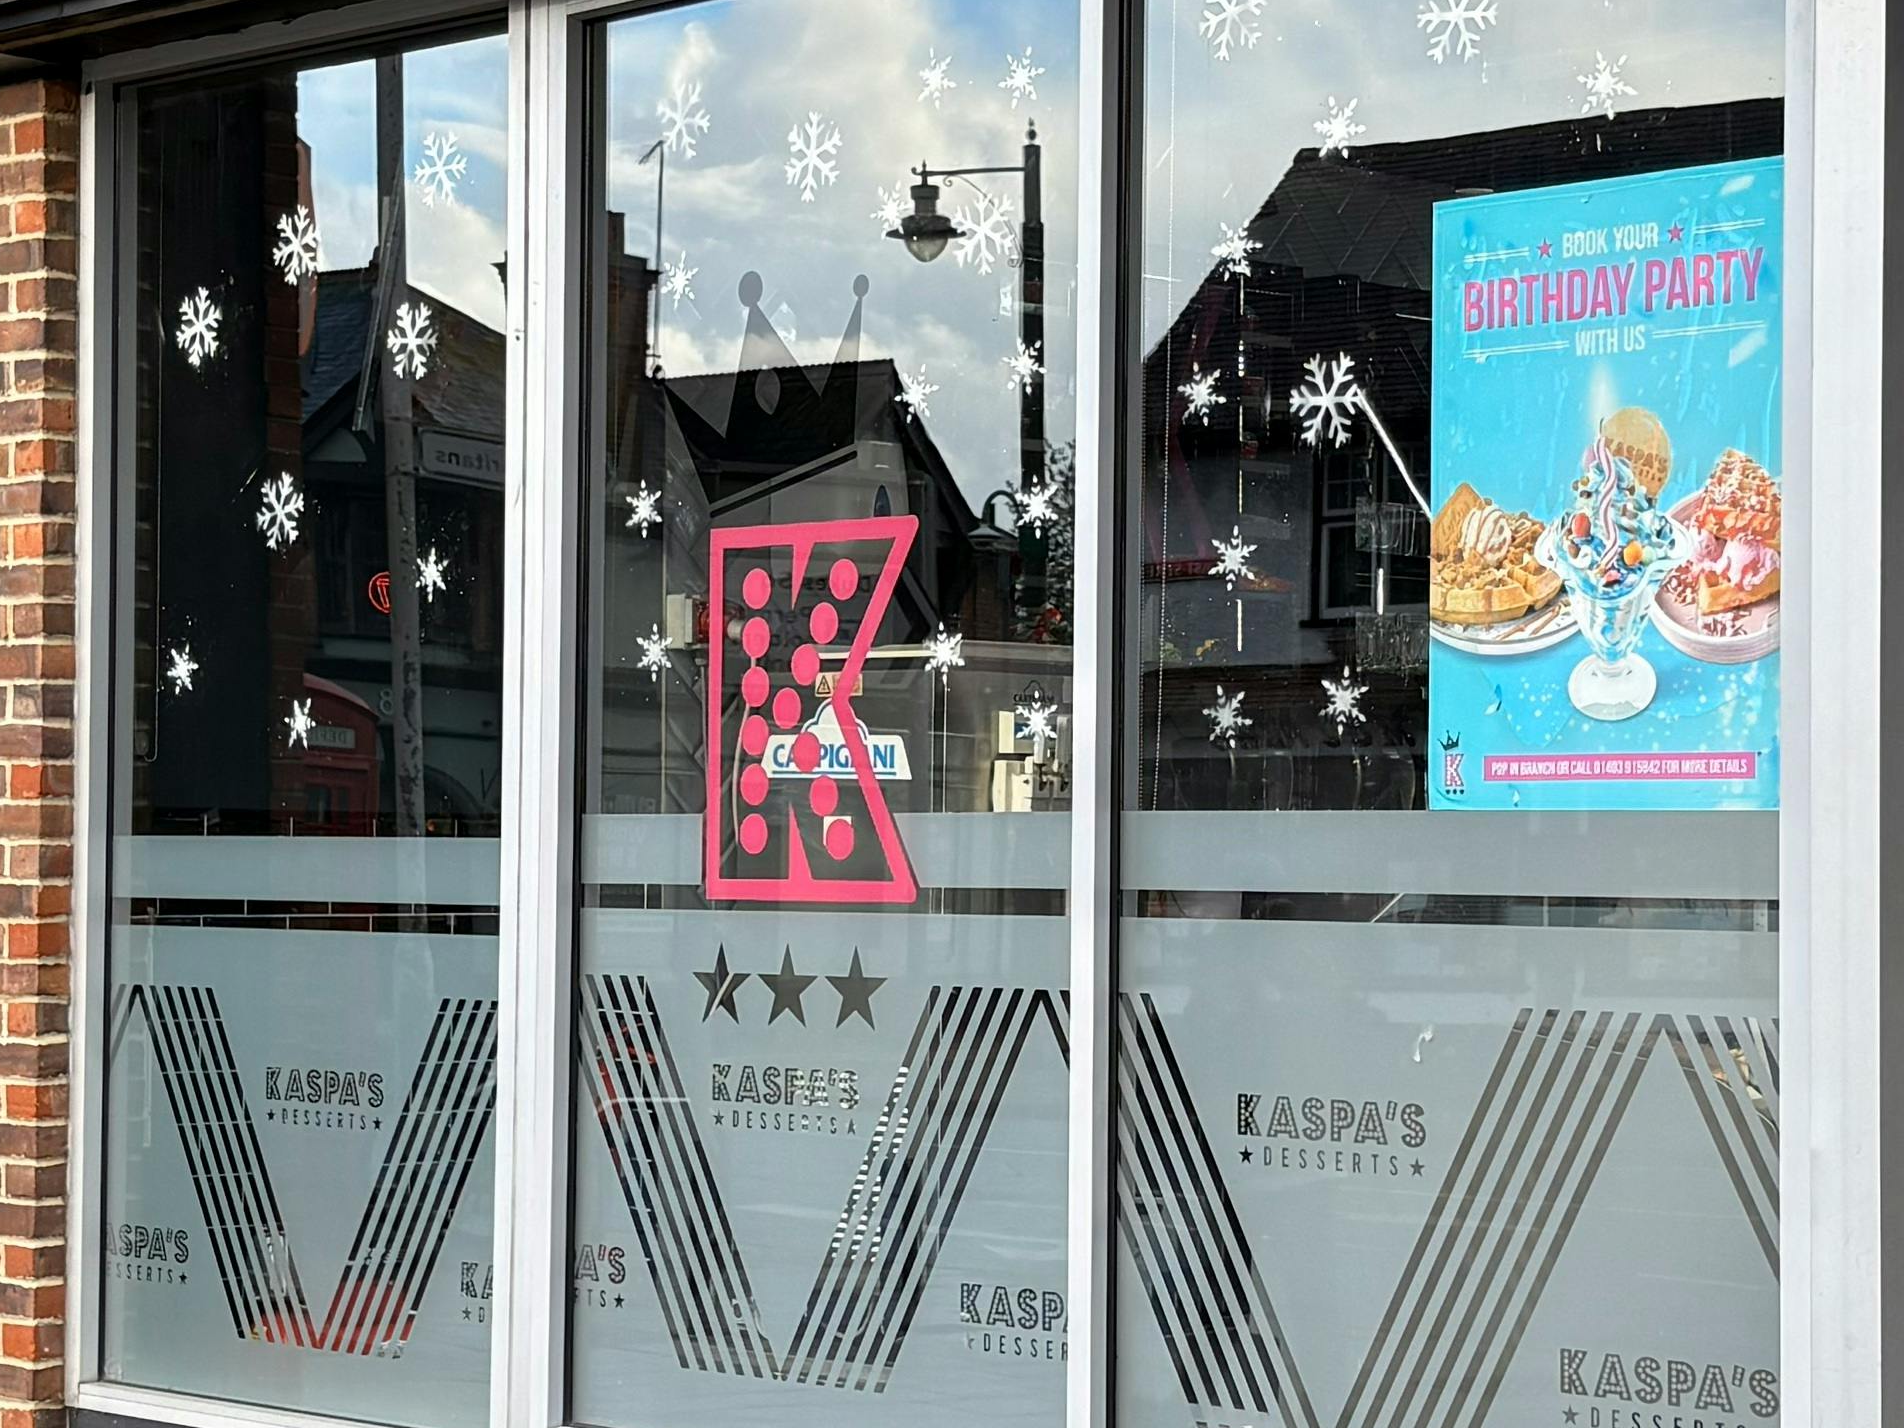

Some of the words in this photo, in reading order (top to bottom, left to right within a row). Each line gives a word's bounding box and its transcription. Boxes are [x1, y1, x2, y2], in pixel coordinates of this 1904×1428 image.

[1563, 228, 1608, 258] BOOK
[1613, 222, 1658, 252] YOUR
[1464, 262, 1636, 332] BIRTHDAY
[1645, 247, 1763, 312] PARTY
[1575, 327, 1619, 357] WITH
[1623, 325, 1646, 352] US
[1570, 760, 1593, 775] CALL
[1662, 759, 1680, 773] FOR
[1709, 758, 1747, 773] DETAILS
[266, 1067, 384, 1107] KASPA'S
[712, 1064, 860, 1109] KASPA'S
[282, 1108, 366, 1130] DESSERTS
[733, 1110, 837, 1134] DESSERTS
[1237, 1093, 1426, 1148] KASPA'S
[1264, 1146, 1398, 1176] DESSERTS
[106, 1222, 189, 1264] ASPA'S
[961, 1283, 1067, 1333] KASP
[984, 1333, 1067, 1361] DESSER
[1560, 1348, 1780, 1418] KASPA'S
